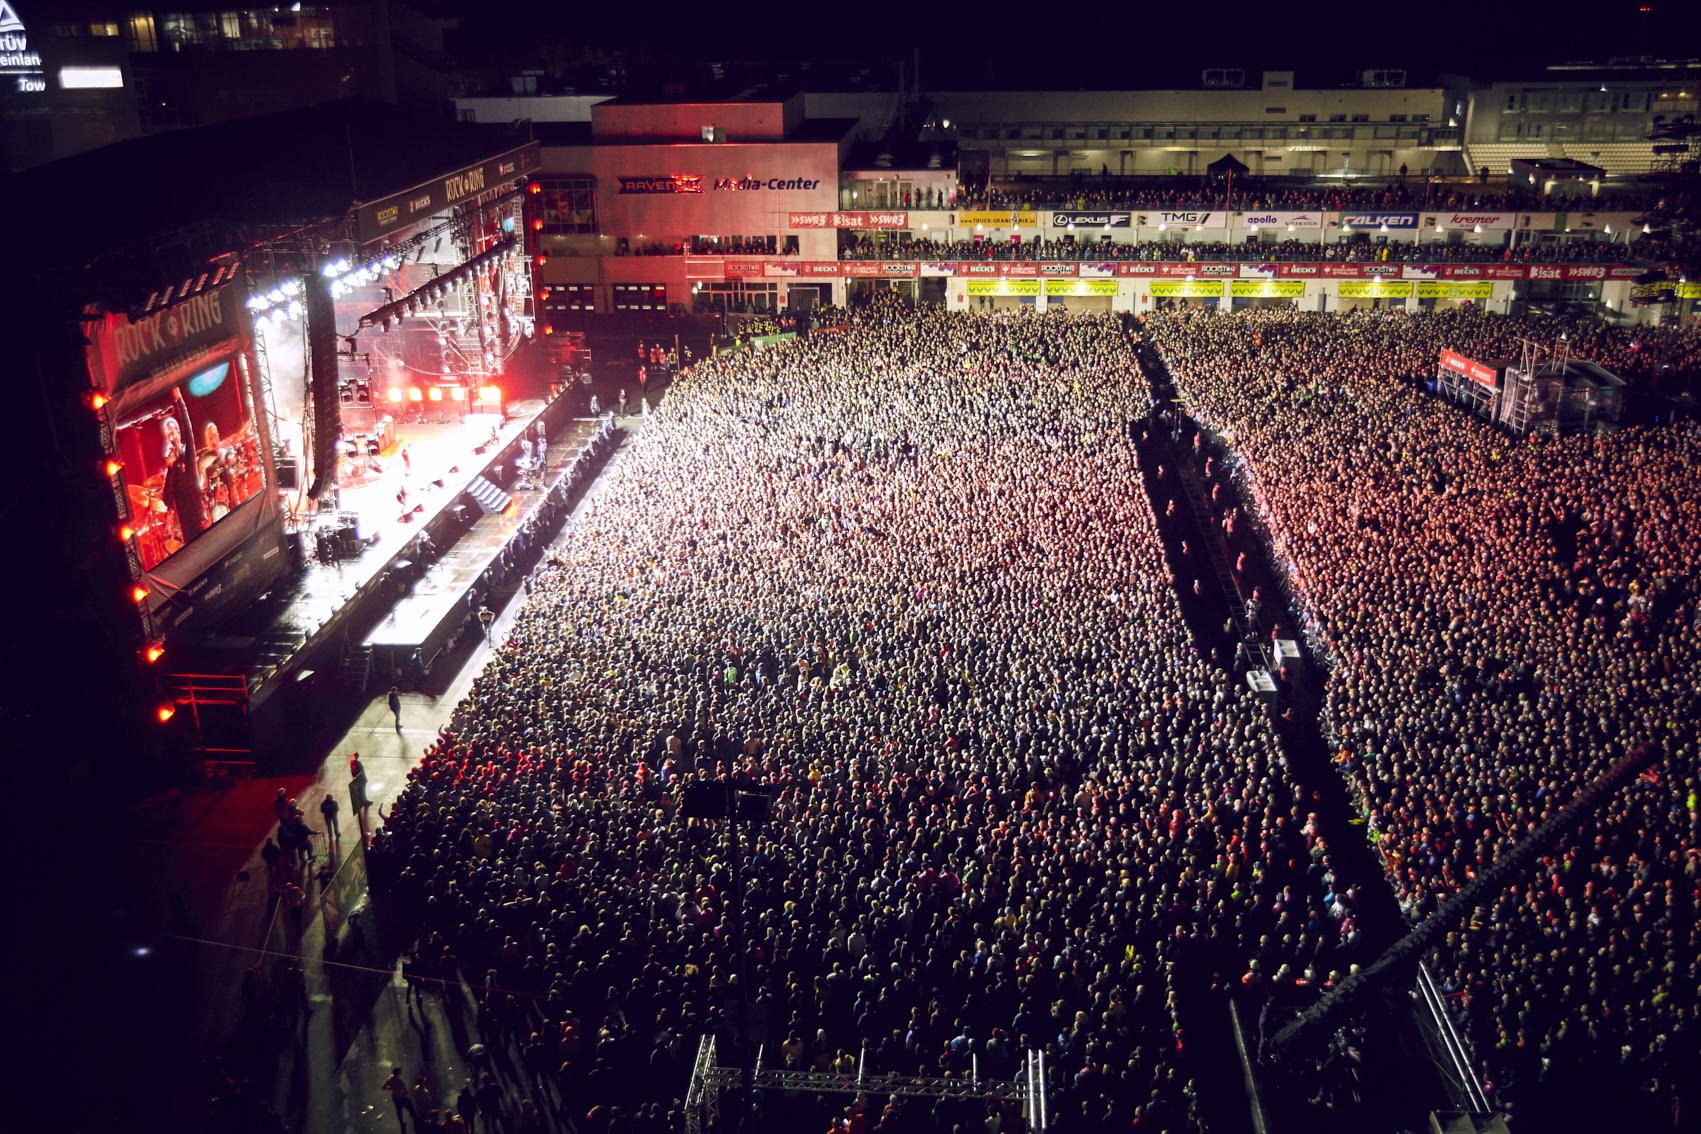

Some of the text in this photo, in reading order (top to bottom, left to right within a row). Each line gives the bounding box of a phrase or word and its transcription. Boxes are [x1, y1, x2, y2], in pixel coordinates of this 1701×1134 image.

[0, 51, 43, 66] einlan
[799, 214, 827, 227] SWR3
[833, 214, 863, 227] 3sat
[878, 214, 906, 227] SWR3
[1069, 216, 1109, 224] LEXUS
[1161, 212, 1197, 222] TMG
[1247, 215, 1278, 225] apollo
[1342, 215, 1414, 226] FALKEN
[1450, 213, 1500, 224] kremer
[1530, 267, 1562, 279] 3sat
[1577, 266, 1606, 278] SWR3
[114, 289, 223, 367] ROCK RING
